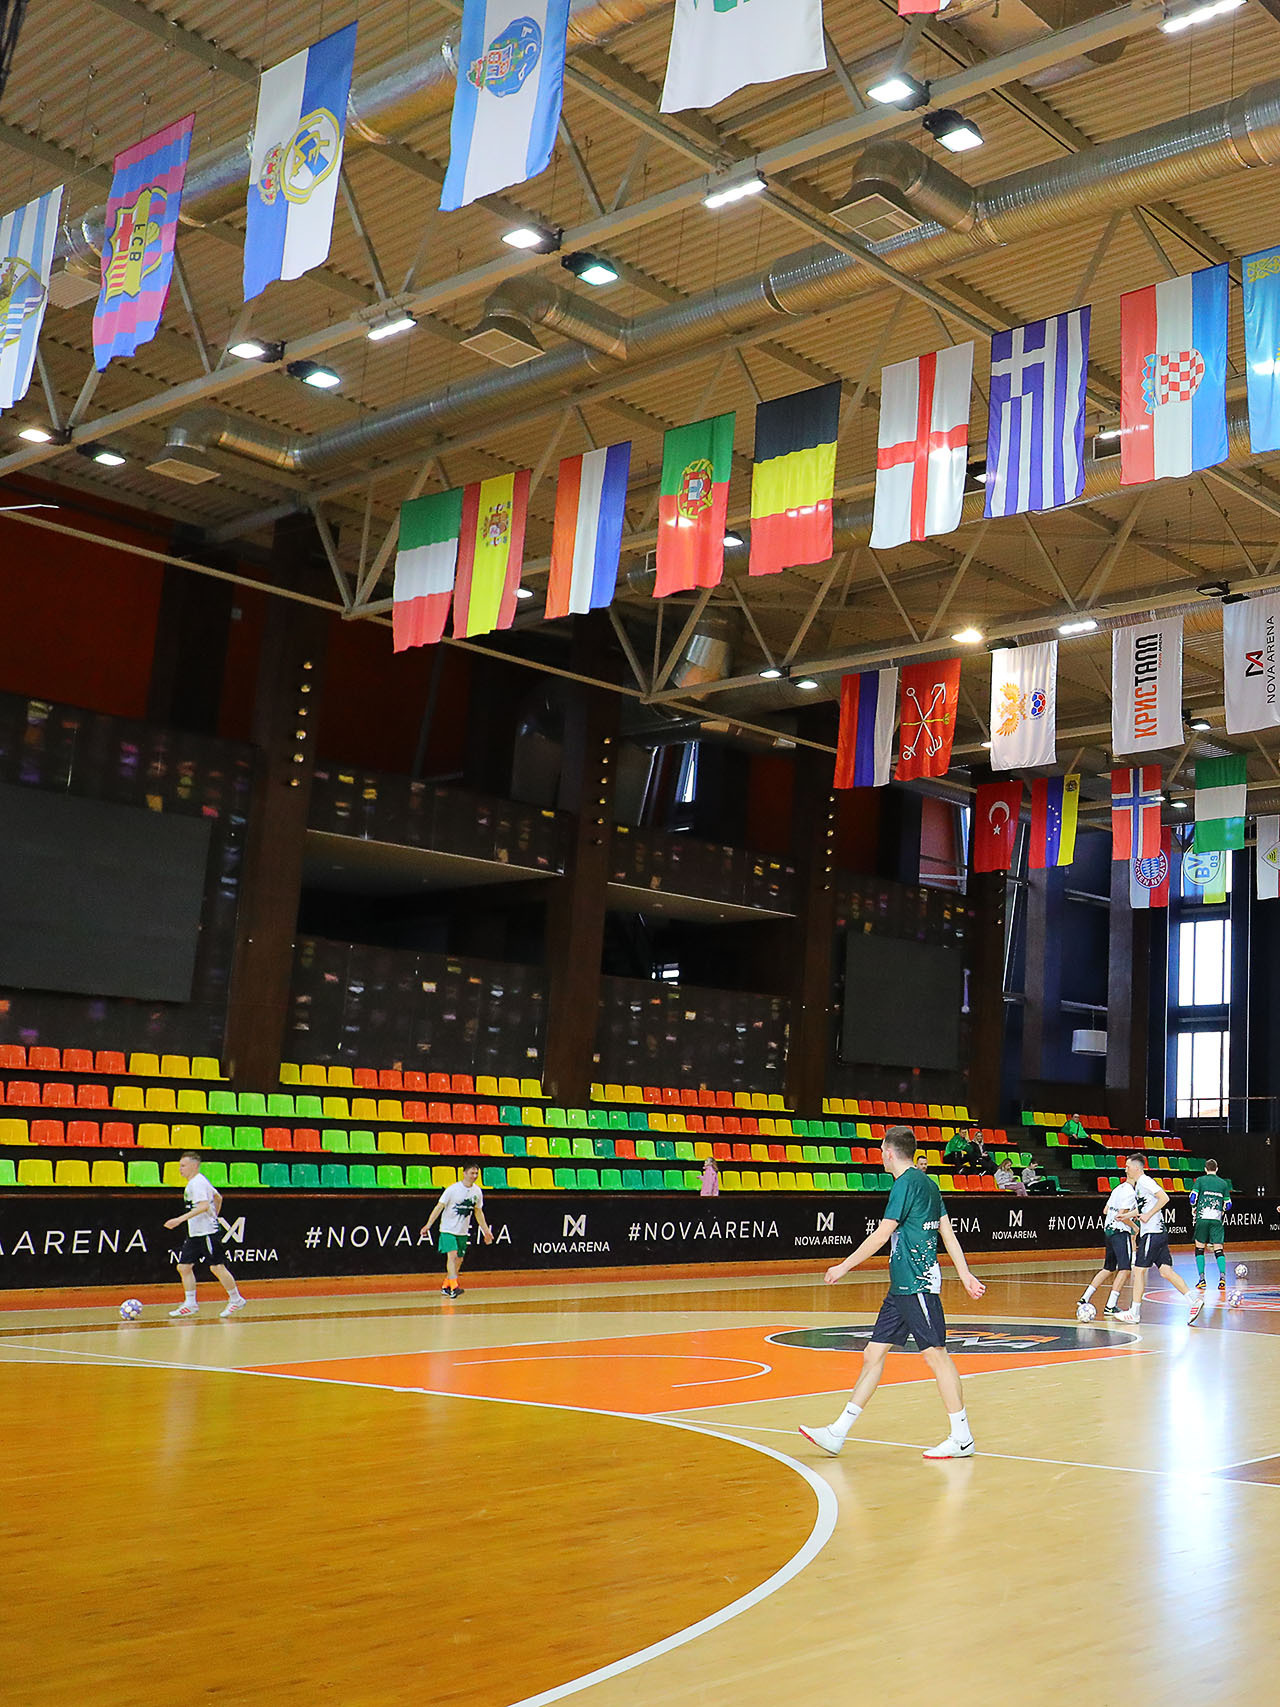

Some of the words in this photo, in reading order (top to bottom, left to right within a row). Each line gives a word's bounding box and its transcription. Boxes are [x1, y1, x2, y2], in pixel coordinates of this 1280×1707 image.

[1265, 615, 1274, 660] ARENA
[1266, 661, 1275, 704] NOVA
[1209, 855, 1218, 868] 09
[1135, 858, 1149, 886] NCHEN
[1048, 1215, 1105, 1232] #NOVAA
[1222, 1212, 1264, 1226] AARENA
[628, 1220, 780, 1242] #NOVAARENA
[992, 1231, 1013, 1240] NOVA
[1012, 1230, 1038, 1239] ARENA
[0, 1229, 148, 1256] ARENA
[533, 1242, 568, 1254] NOVA
[569, 1241, 611, 1253] ARENA
[794, 1236, 821, 1246] NOVA
[821, 1234, 853, 1245] ARENA
